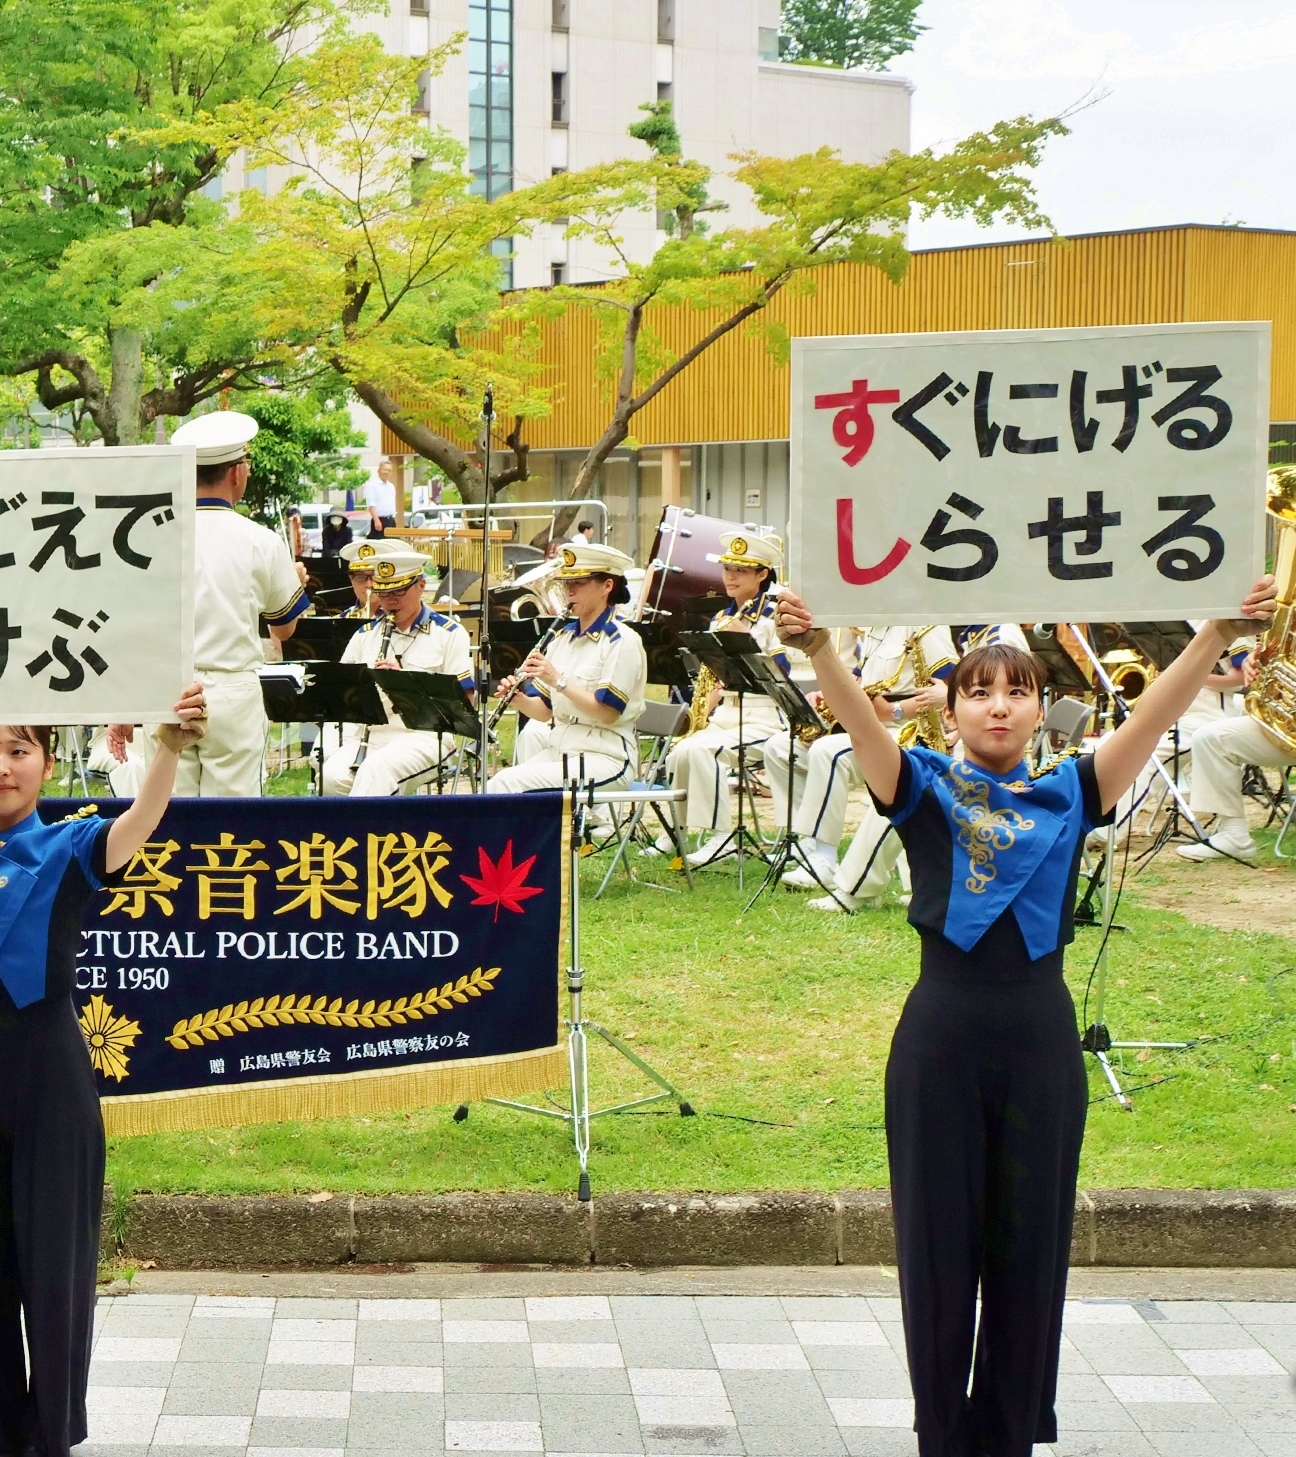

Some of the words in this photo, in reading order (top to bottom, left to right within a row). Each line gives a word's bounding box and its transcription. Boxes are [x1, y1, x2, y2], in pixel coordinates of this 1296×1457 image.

[814, 360, 1233, 467] すぐにげる
[836, 490, 1225, 586] しらせる
[216, 932, 346, 960] POLICE
[356, 931, 460, 960] BAND
[117, 967, 170, 991] 1950
[209, 1057, 225, 1075] 贈
[239, 1047, 332, 1073] 広島県警友会
[346, 1031, 471, 1061] 広島県警察友の会
